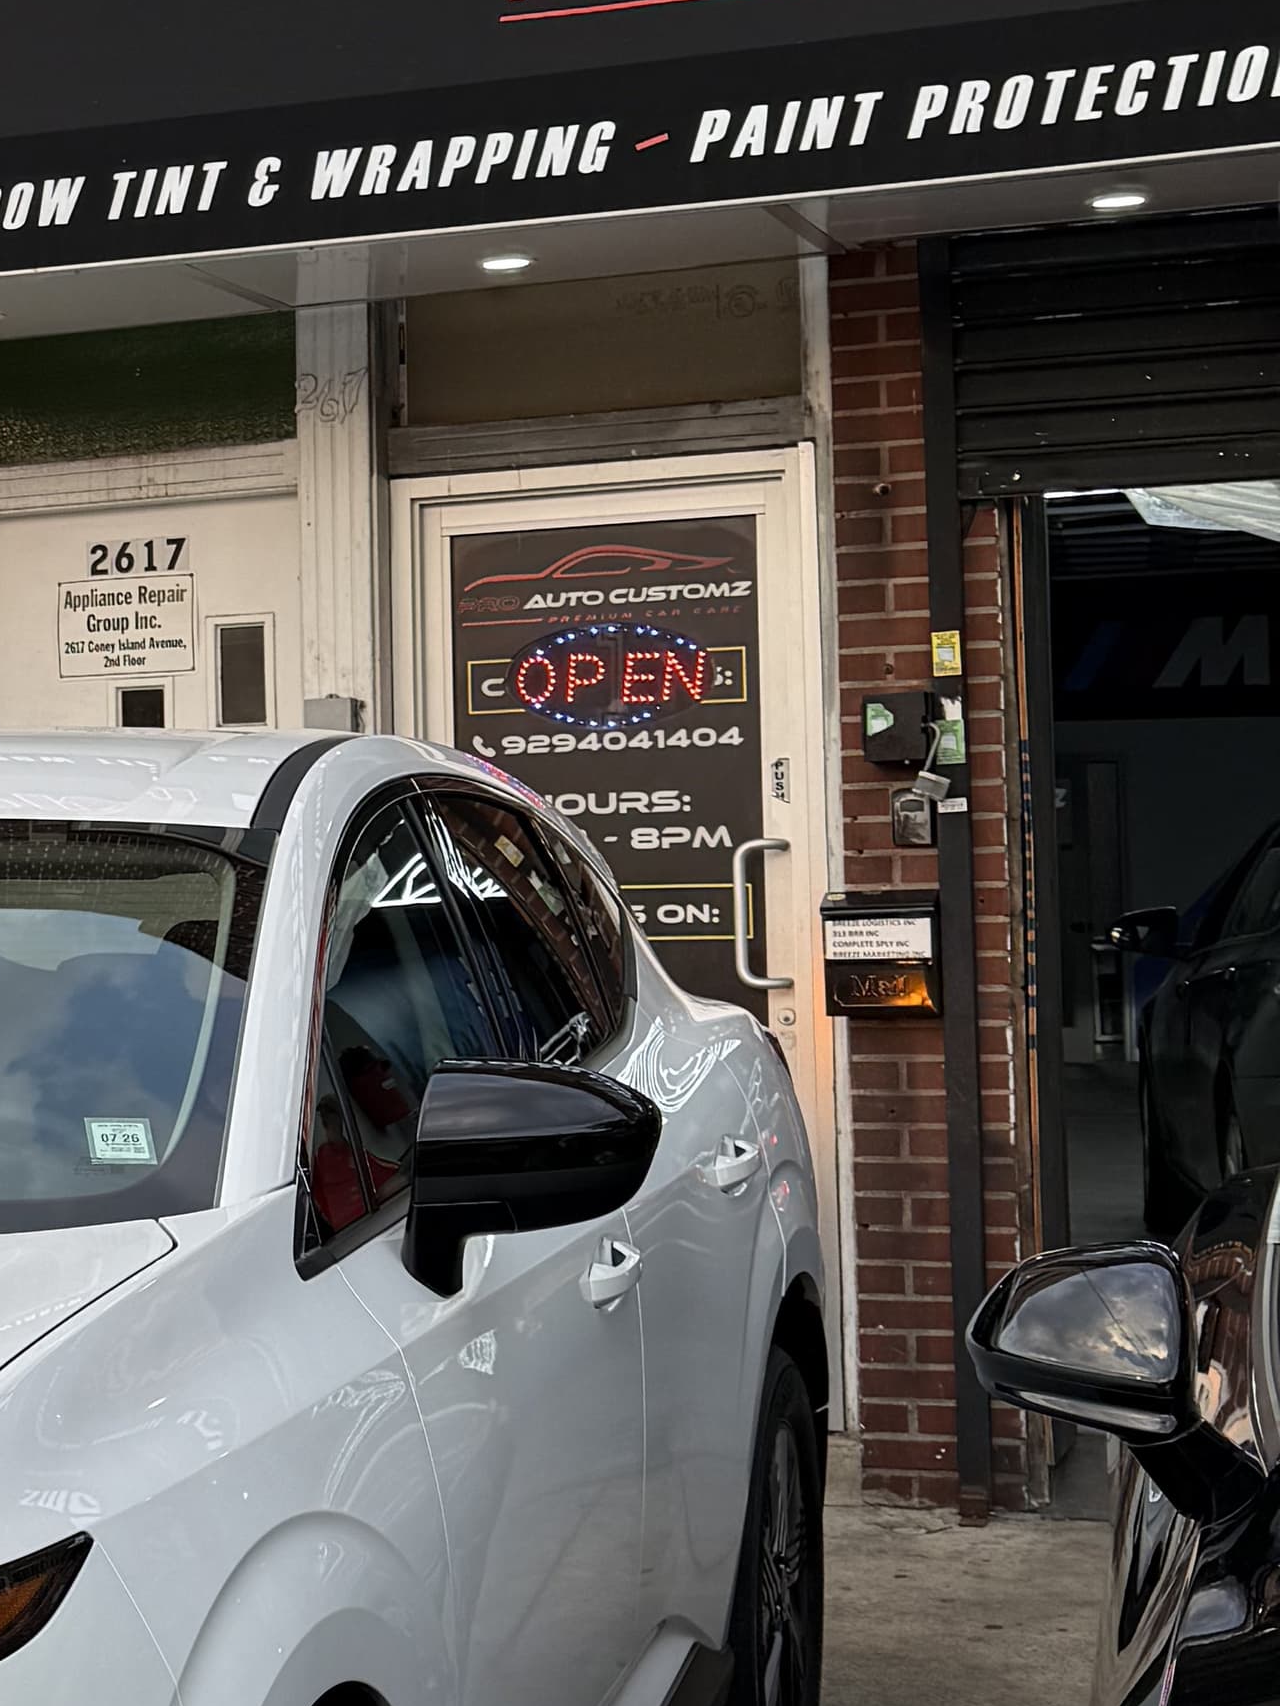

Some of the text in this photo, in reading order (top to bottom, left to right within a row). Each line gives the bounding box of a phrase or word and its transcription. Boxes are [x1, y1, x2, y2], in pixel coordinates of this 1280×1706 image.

[107, 161, 227, 222] TINT
[247, 157, 281, 208] &
[310, 121, 617, 200] WRAPPING
[690, 92, 885, 163] PAINT
[906, 44, 1280, 139] PROTECTIO
[90, 537, 186, 576] 2617
[64, 583, 187, 613] Appliance Repair
[523, 590, 604, 611] AUTO
[609, 581, 752, 605] CUSTOMZ
[87, 611, 162, 634] Group Inc.
[64, 637, 187, 654] 2617 Coney Island Avenue,
[103, 655, 146, 668] 2nd Floor
[516, 649, 708, 706] OPEN
[501, 726, 745, 756] 9294041404
[630, 825, 733, 849] 8PM
[656, 903, 720, 924] ON:
[101, 1133, 117, 1143] 07
